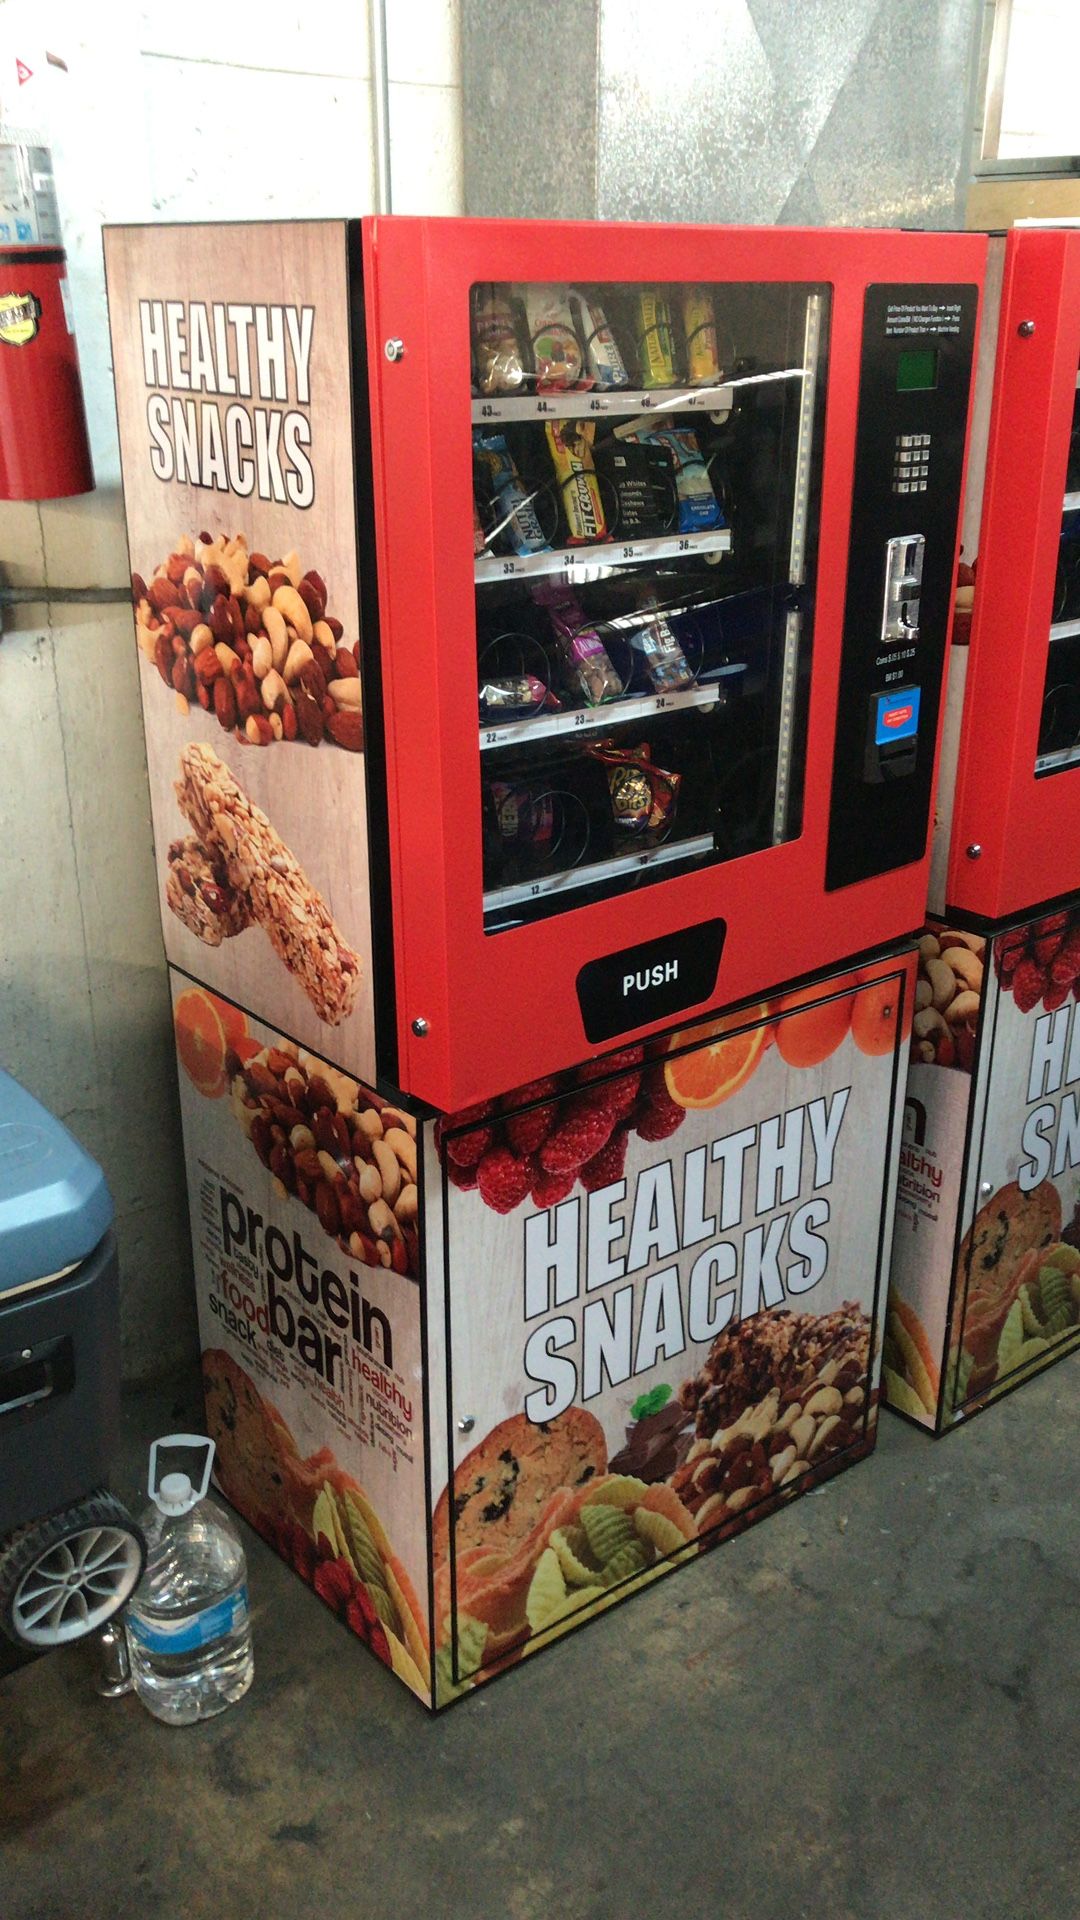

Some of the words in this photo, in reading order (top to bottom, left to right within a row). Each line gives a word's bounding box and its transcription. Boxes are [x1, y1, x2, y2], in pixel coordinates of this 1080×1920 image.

[139, 299, 315, 405] HEALTHY
[481, 405, 493, 417] 43
[537, 401, 548, 412] 44
[590, 399, 601, 411] 45
[146, 393, 315, 510] SNACKS
[571, 461, 592, 511] CRUNH
[581, 510, 597, 537] FIT
[564, 555, 575, 566] 34
[623, 547, 634, 558] 35
[679, 540, 689, 550] 36
[503, 563, 515, 574] 33
[575, 714, 585, 725] 23
[656, 698, 665, 709] 24
[486, 732, 497, 744] 22
[531, 885, 540, 895] 12
[623, 959, 678, 996] PUSH
[524, 1086, 852, 1322] HEALTHY
[220, 1185, 393, 1370] protein
[220, 1270, 269, 1335] food
[523, 1197, 831, 1424] SNACKS
[208, 1292, 256, 1349] snack
[267, 1269, 342, 1386] bar
[351, 1348, 413, 1422] healthy
[365, 1391, 413, 1440] nutrition
